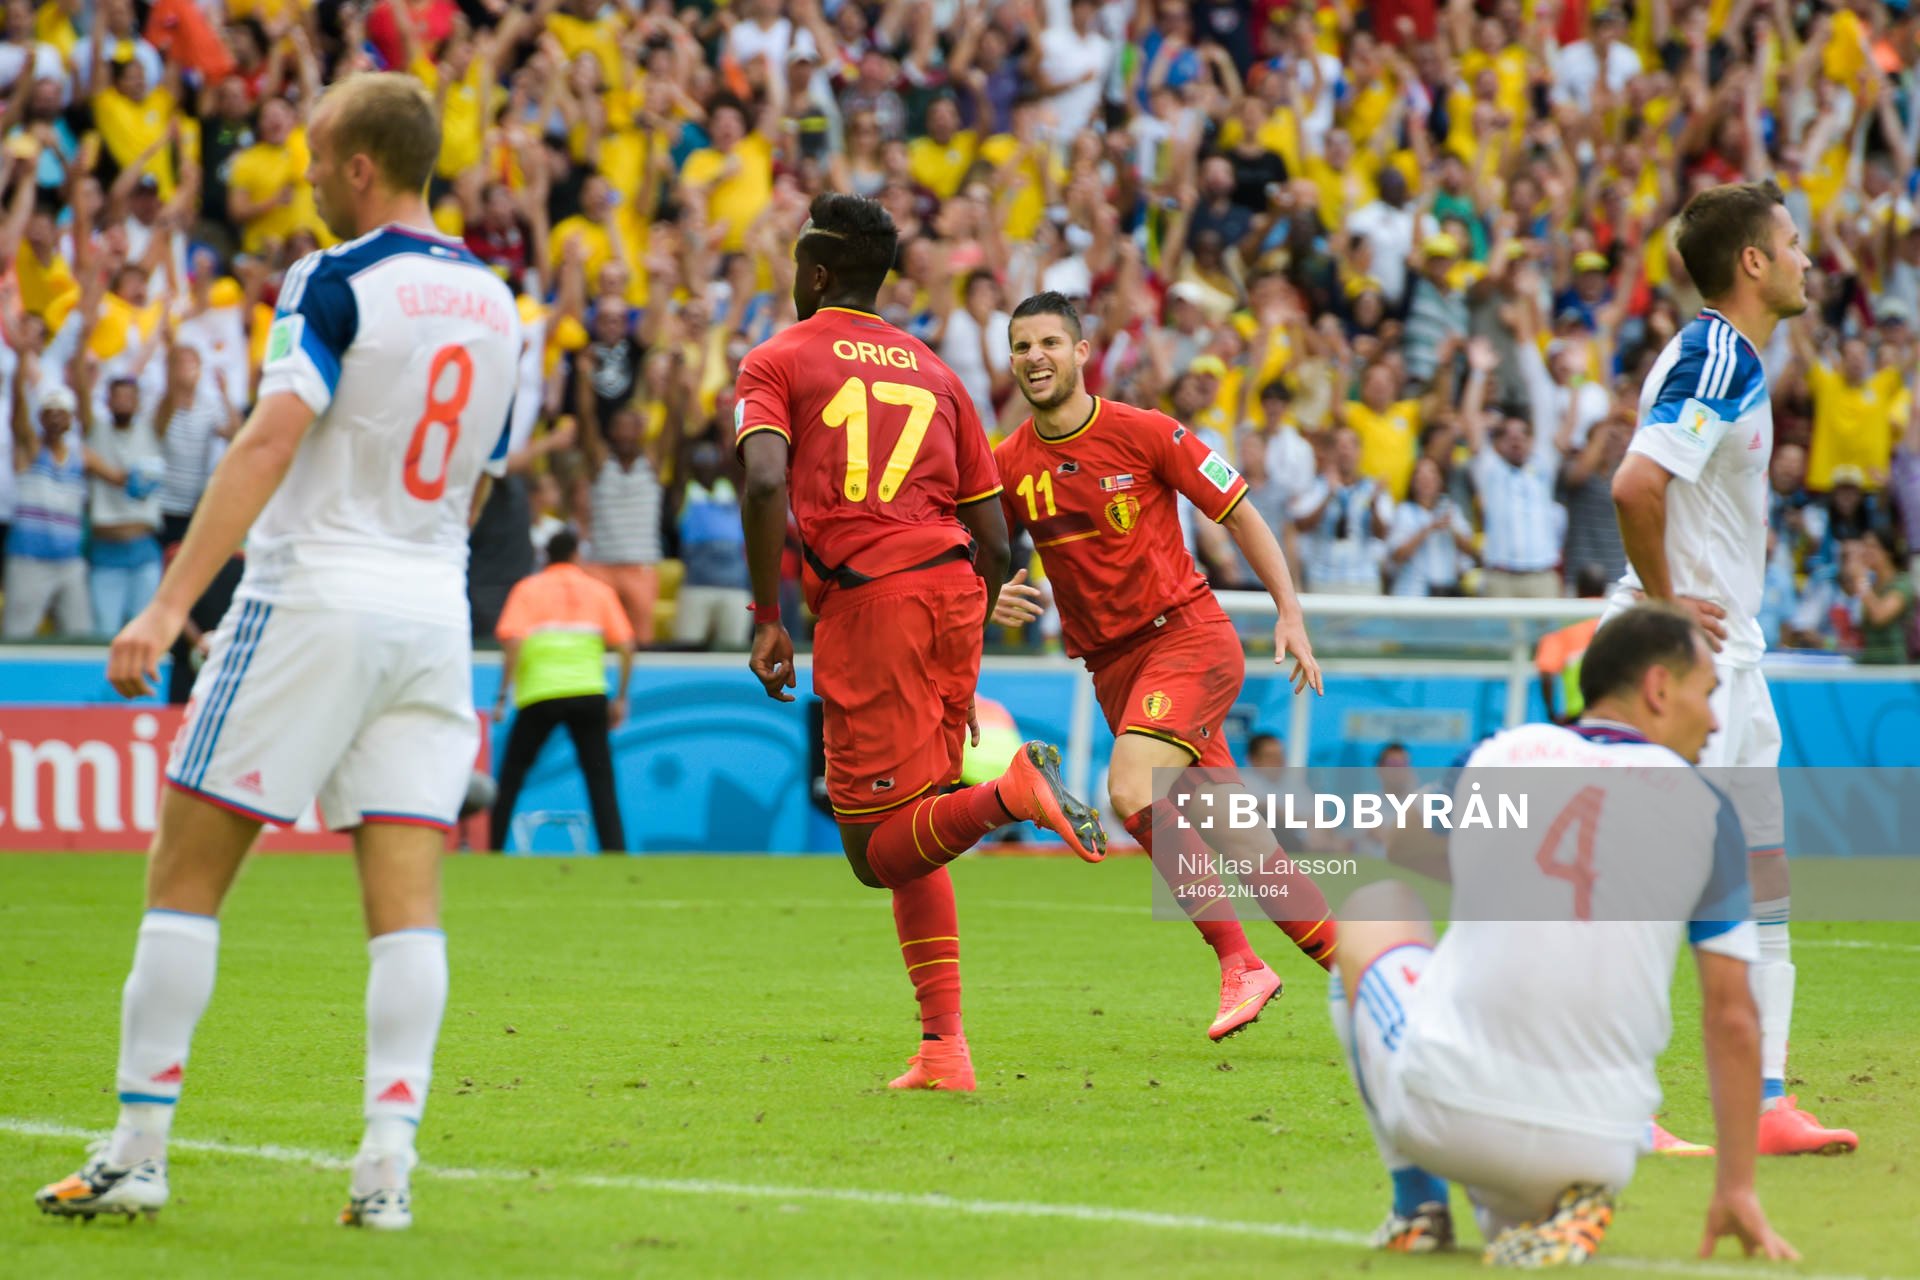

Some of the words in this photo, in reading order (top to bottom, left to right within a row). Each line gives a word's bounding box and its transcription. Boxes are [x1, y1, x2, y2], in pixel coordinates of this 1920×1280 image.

[833, 340, 919, 371] ORIGI
[403, 343, 474, 501] 8
[822, 376, 937, 503] 17
[1016, 470, 1056, 521] 11
[1535, 785, 1605, 922] 4
